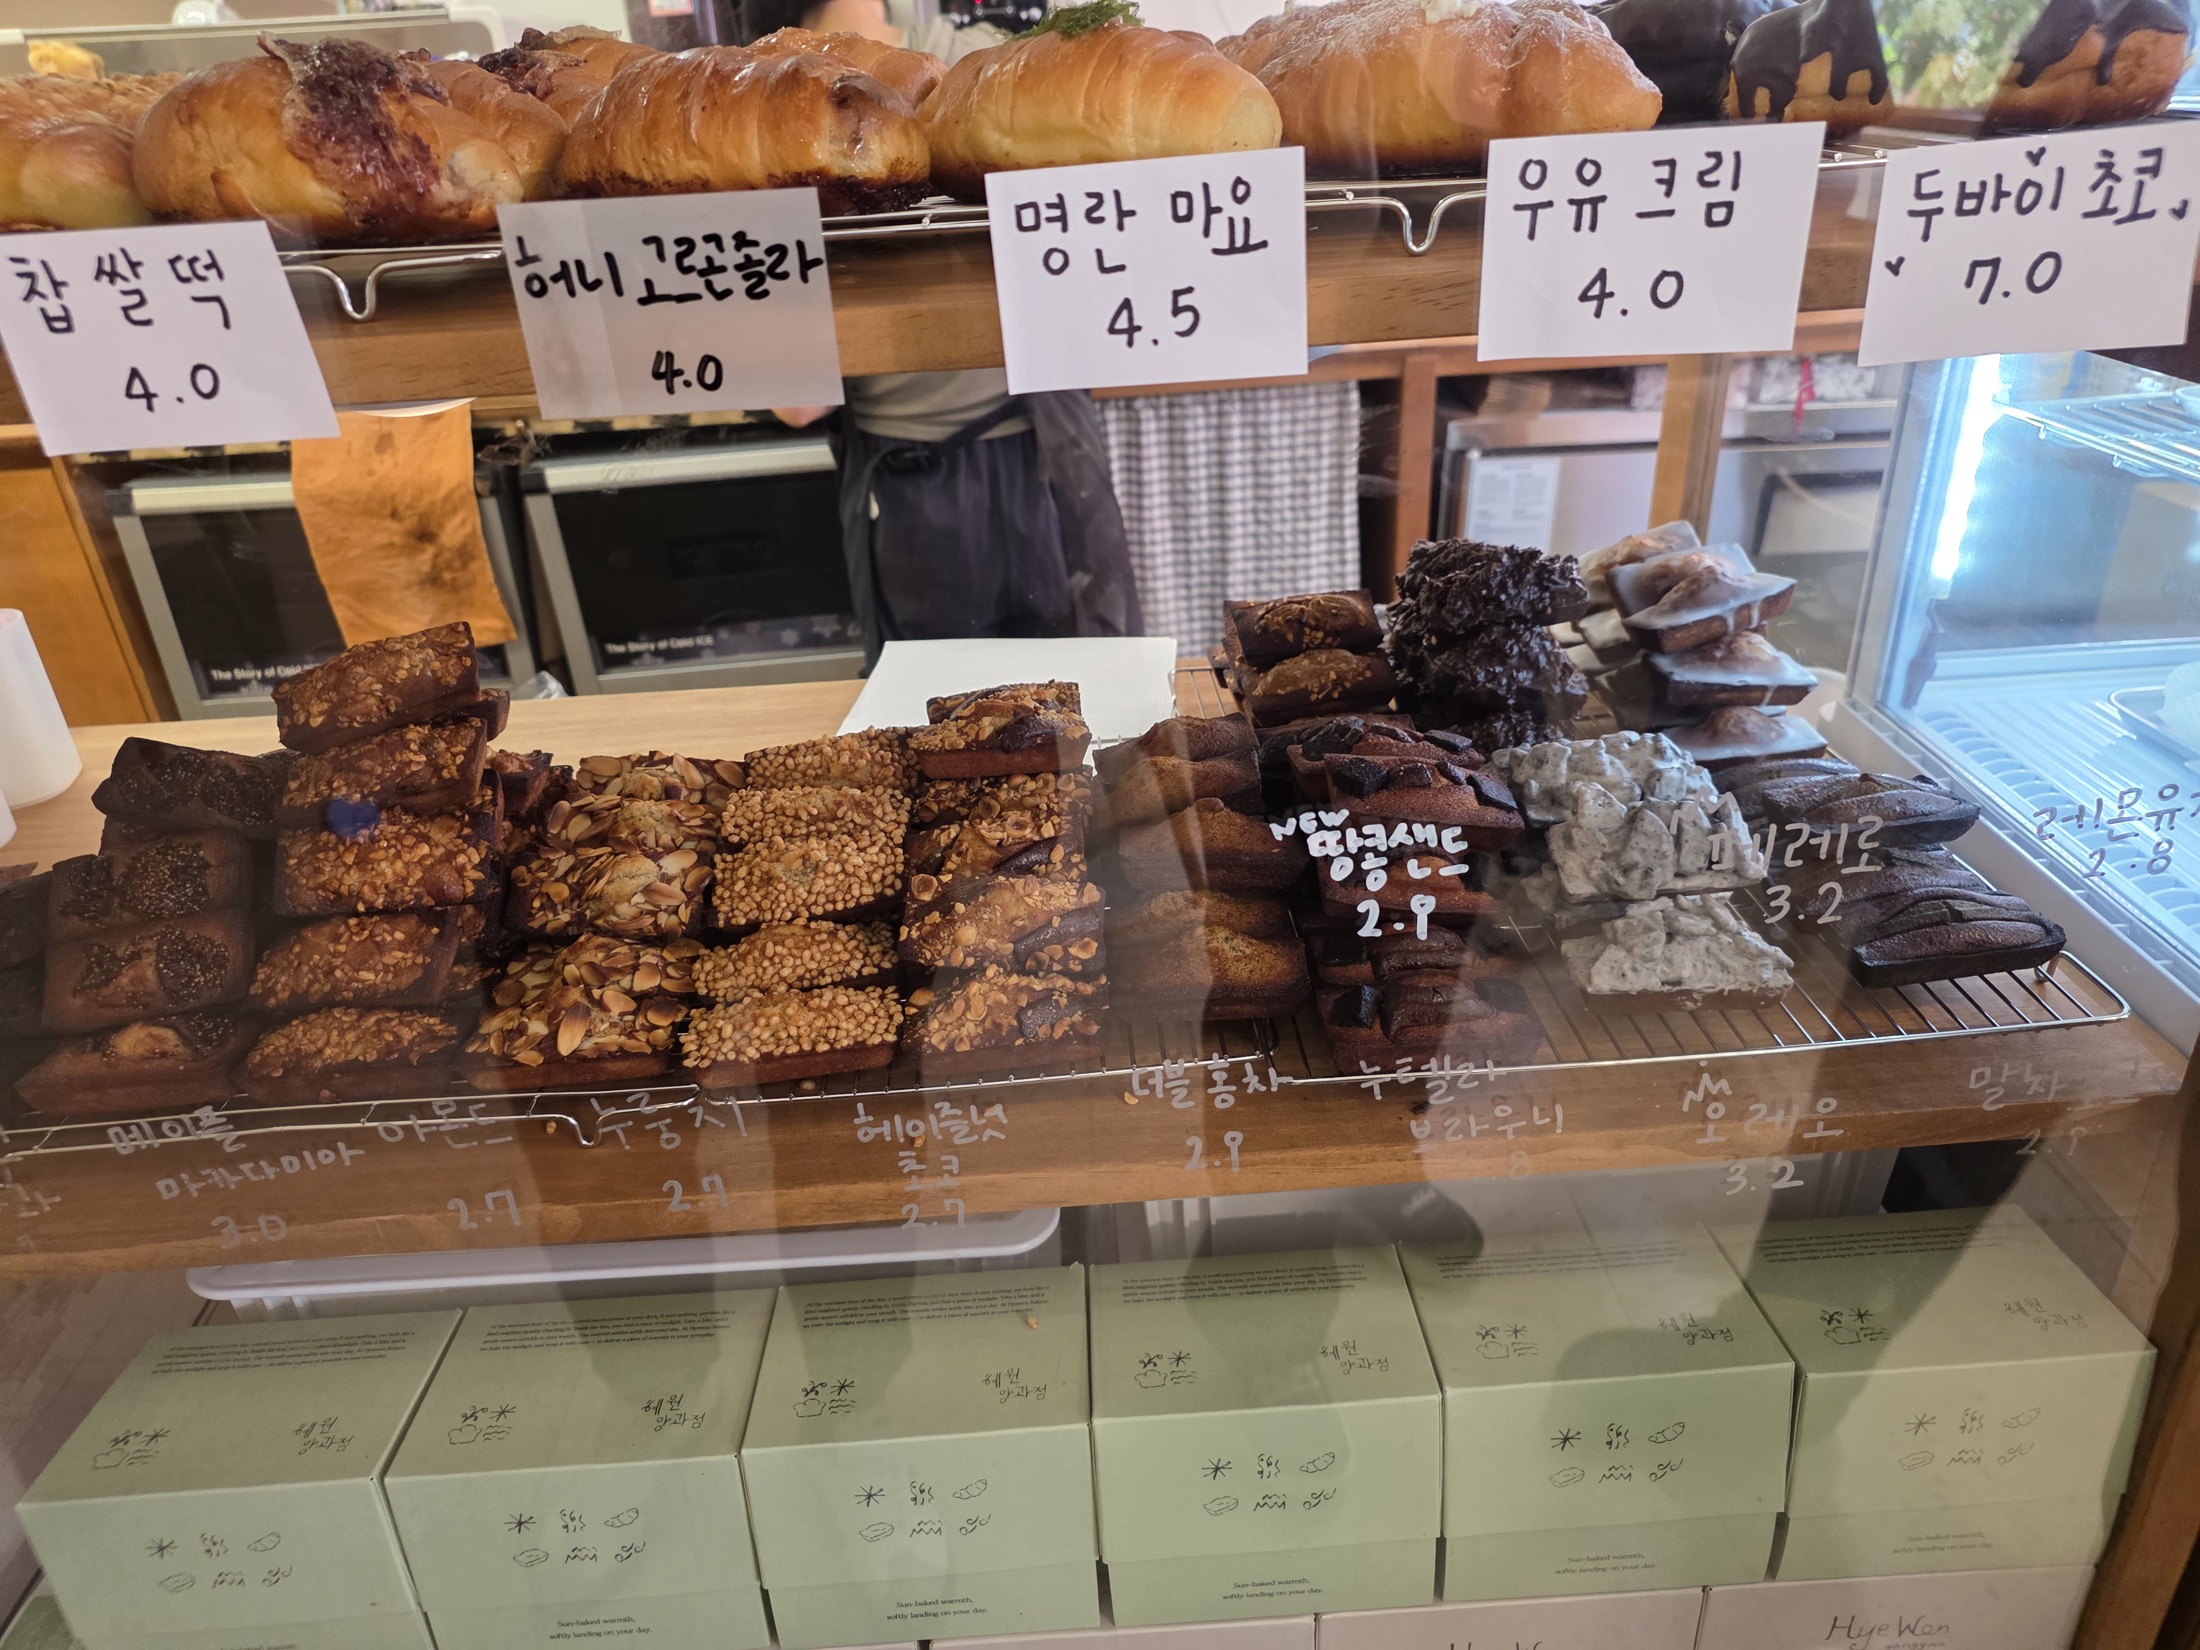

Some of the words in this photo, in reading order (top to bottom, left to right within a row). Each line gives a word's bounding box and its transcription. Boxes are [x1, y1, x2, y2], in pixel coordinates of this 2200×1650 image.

[1906, 166, 2065, 243] 두바이
[2080, 147, 2165, 227] 초코
[1014, 189, 1136, 276] 명란
[1170, 175, 1269, 256] 마요
[515, 235, 624, 299] 허니
[637, 229, 825, 306] 고르곤졸라
[1964, 250, 2063, 306] 7.0
[8, 246, 232, 335] 찹쌀떡
[1577, 266, 1685, 320] 4.0
[1107, 285, 1201, 349] 4.5
[124, 362, 221, 414] 4.0
[651, 350, 724, 395] 4.0
[1269, 809, 1350, 841] NEW
[2082, 838, 2174, 879] 2.8
[1356, 893, 1437, 941] 2.9
[1764, 881, 1844, 925] 3.2
[1359, 1055, 1508, 1105] 누텔라
[106, 1104, 247, 1155] 메이플
[377, 1099, 514, 1150] 아몬드
[590, 1091, 748, 1151] 누룽지
[1410, 1104, 1563, 1154] 브라우니
[155, 1140, 366, 1200] 마카다미아
[898, 1151, 962, 1191] 초코
[1184, 1131, 1244, 1172] 2.9
[662, 1173, 729, 1213] 2.7
[1724, 1159, 1805, 1196] 3.2
[447, 1189, 522, 1230] 2.7
[901, 1199, 967, 1230] 2.7
[210, 1213, 288, 1250] 3.0
[1340, 1356, 1389, 1376] 양과점
[999, 1383, 1047, 1404] 양과점
[654, 1411, 706, 1432] 양과점
[298, 1434, 355, 1455] 양과점
[896, 1599, 939, 1609] Sun-baked
[1222, 1592, 1244, 1600] softly
[1246, 1590, 1274, 1599] landing
[1288, 1588, 1306, 1597] your
[1233, 1579, 1275, 1589] Sun-baked
[549, 1632, 571, 1640] softly
[573, 1630, 602, 1639] landing
[616, 1628, 634, 1636] your
[557, 1618, 600, 1628] Sun-baked
[887, 1612, 908, 1621] softly
[910, 1610, 939, 1619] landing
[952, 1608, 970, 1617] your
